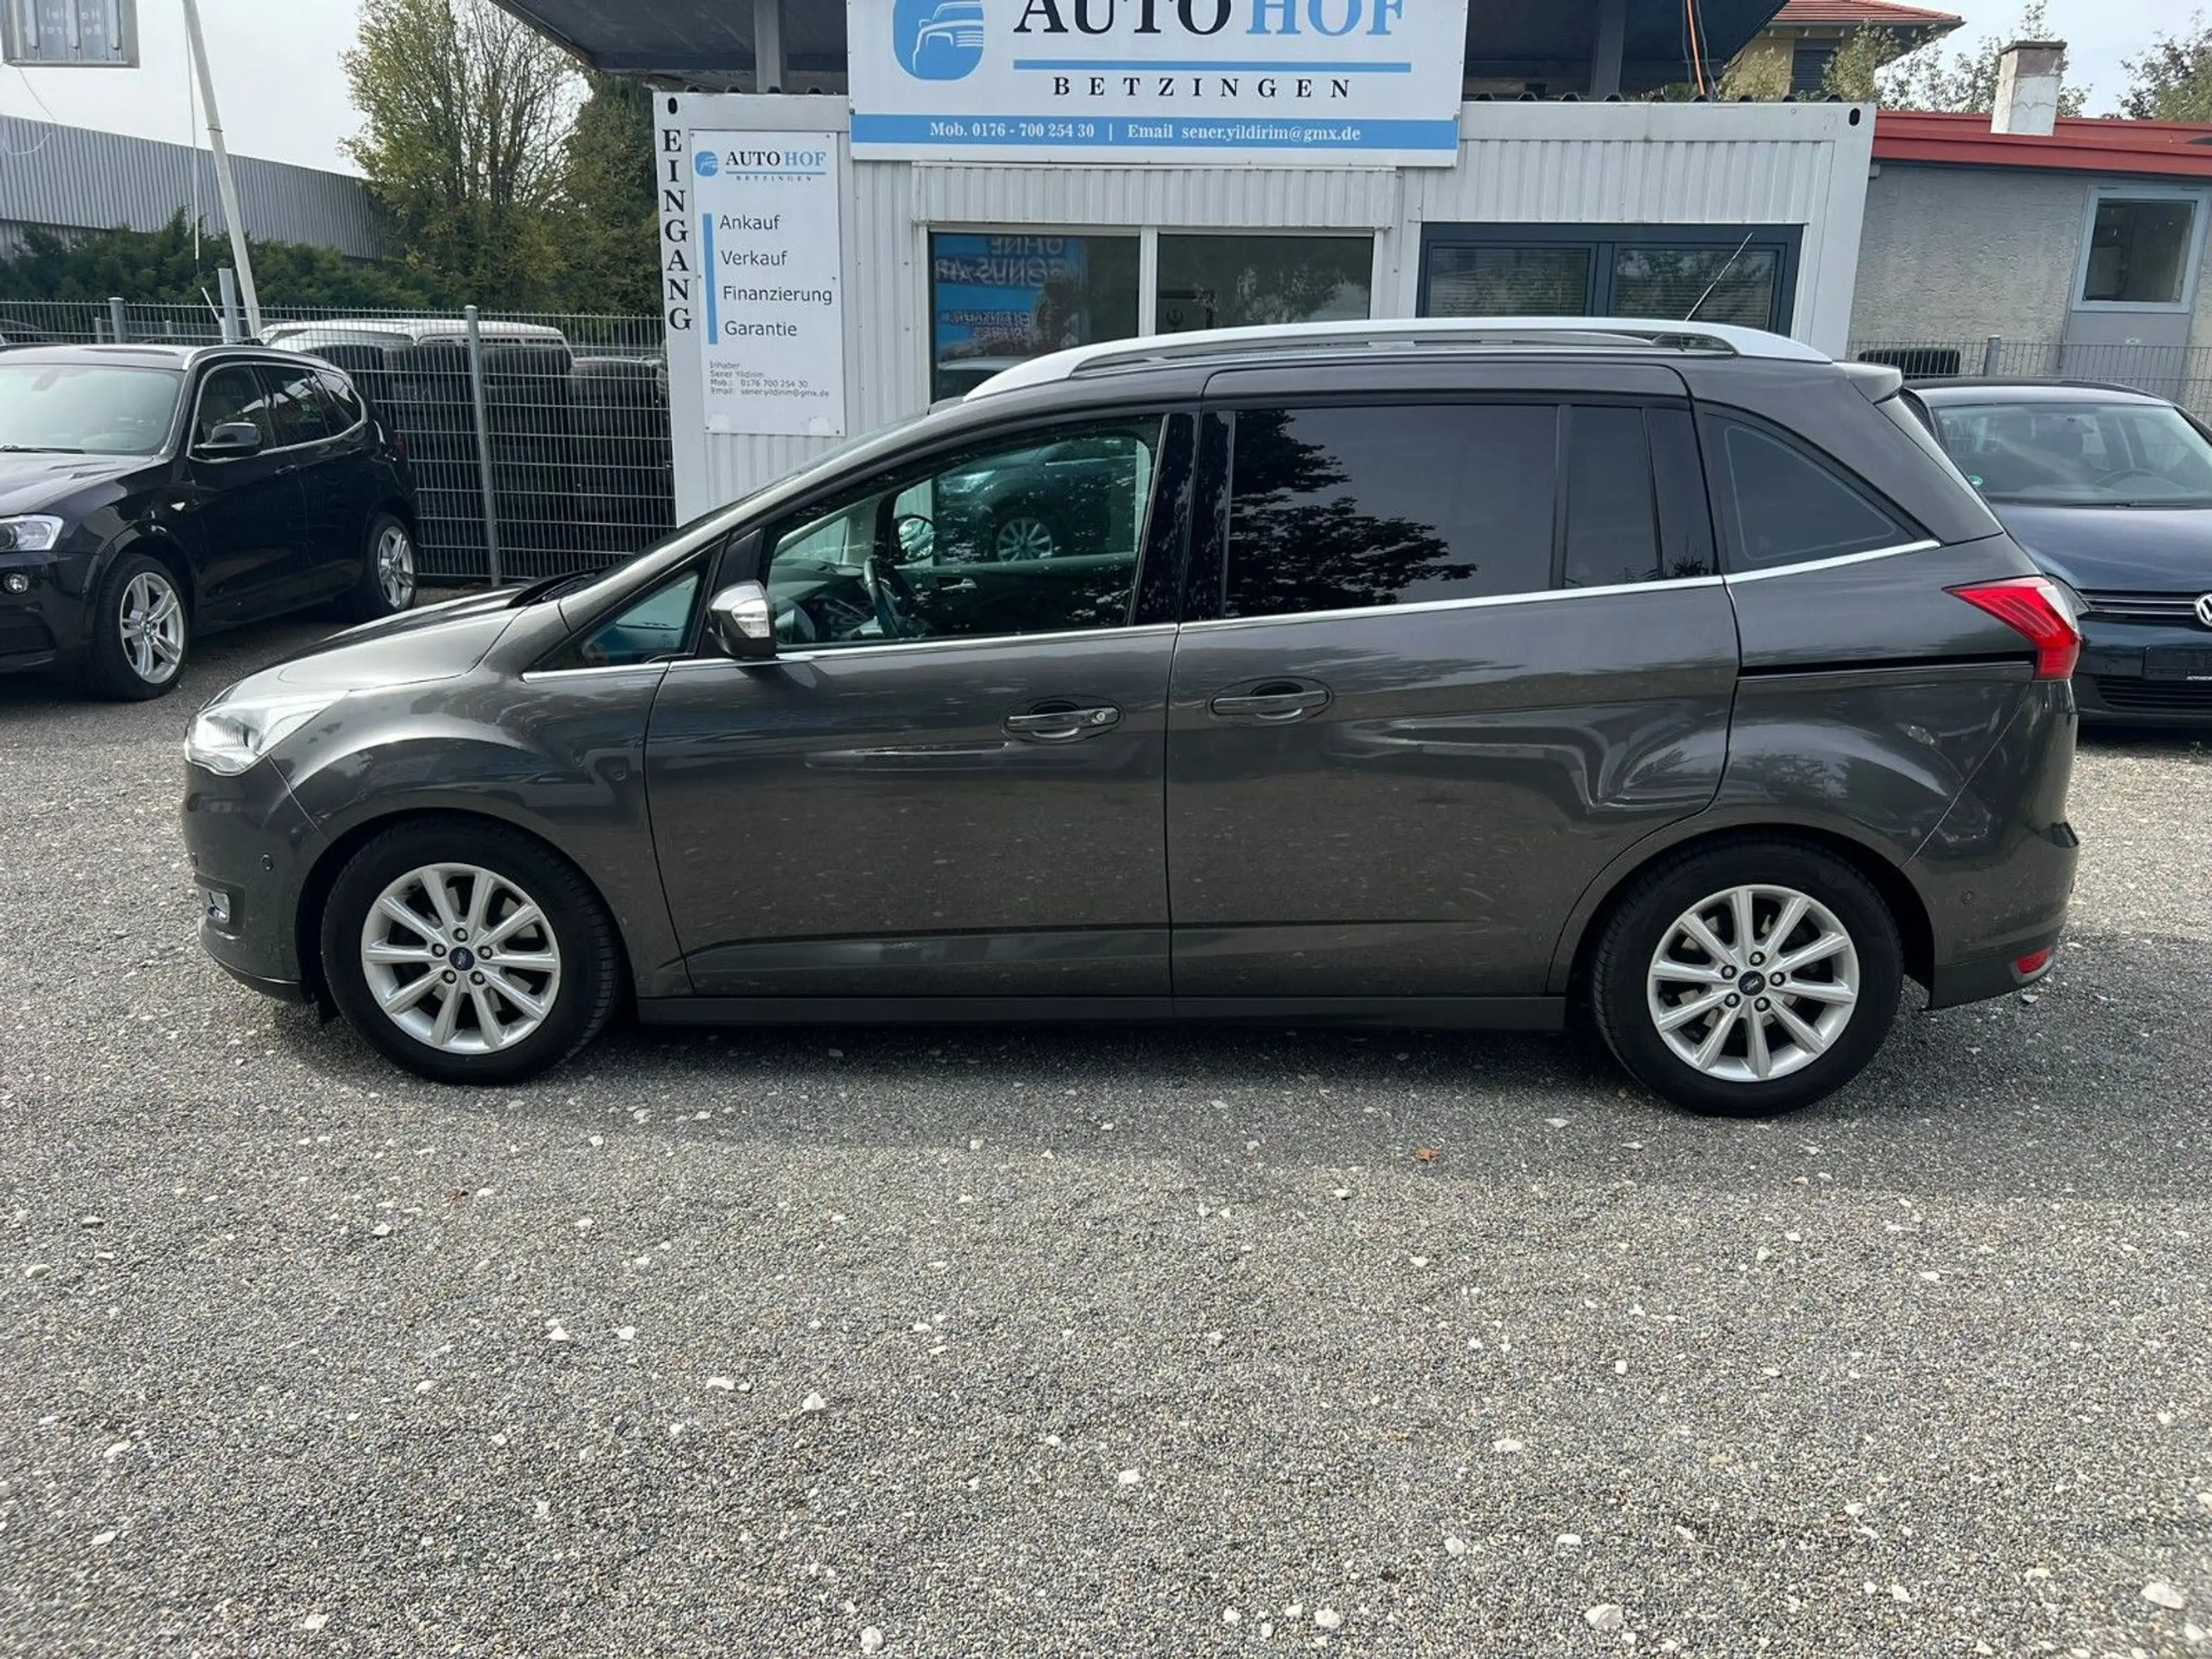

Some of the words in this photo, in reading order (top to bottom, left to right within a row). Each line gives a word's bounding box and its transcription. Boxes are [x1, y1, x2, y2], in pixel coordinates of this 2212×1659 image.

[1013, 0, 1232, 35] AUTO
[1246, 0, 1404, 36] HOF
[1054, 77, 1350, 98] BETZINGEN
[929, 122, 968, 137] Mob.
[972, 122, 1006, 137] 0176
[1018, 123, 1044, 138] 700
[1047, 123, 1074, 138] 254
[1077, 123, 1094, 138] 30
[1127, 123, 1173, 139] Email
[1181, 124, 1361, 142] sener.yildirim@gmx.de
[725, 151, 781, 166] AUTO
[785, 151, 827, 166] HOF
[662, 128, 692, 331] EINGANG
[719, 214, 781, 230] Ankauf
[721, 249, 788, 266] Verkauf
[724, 286, 832, 305] Finanzierung
[724, 320, 798, 336] Garantie
